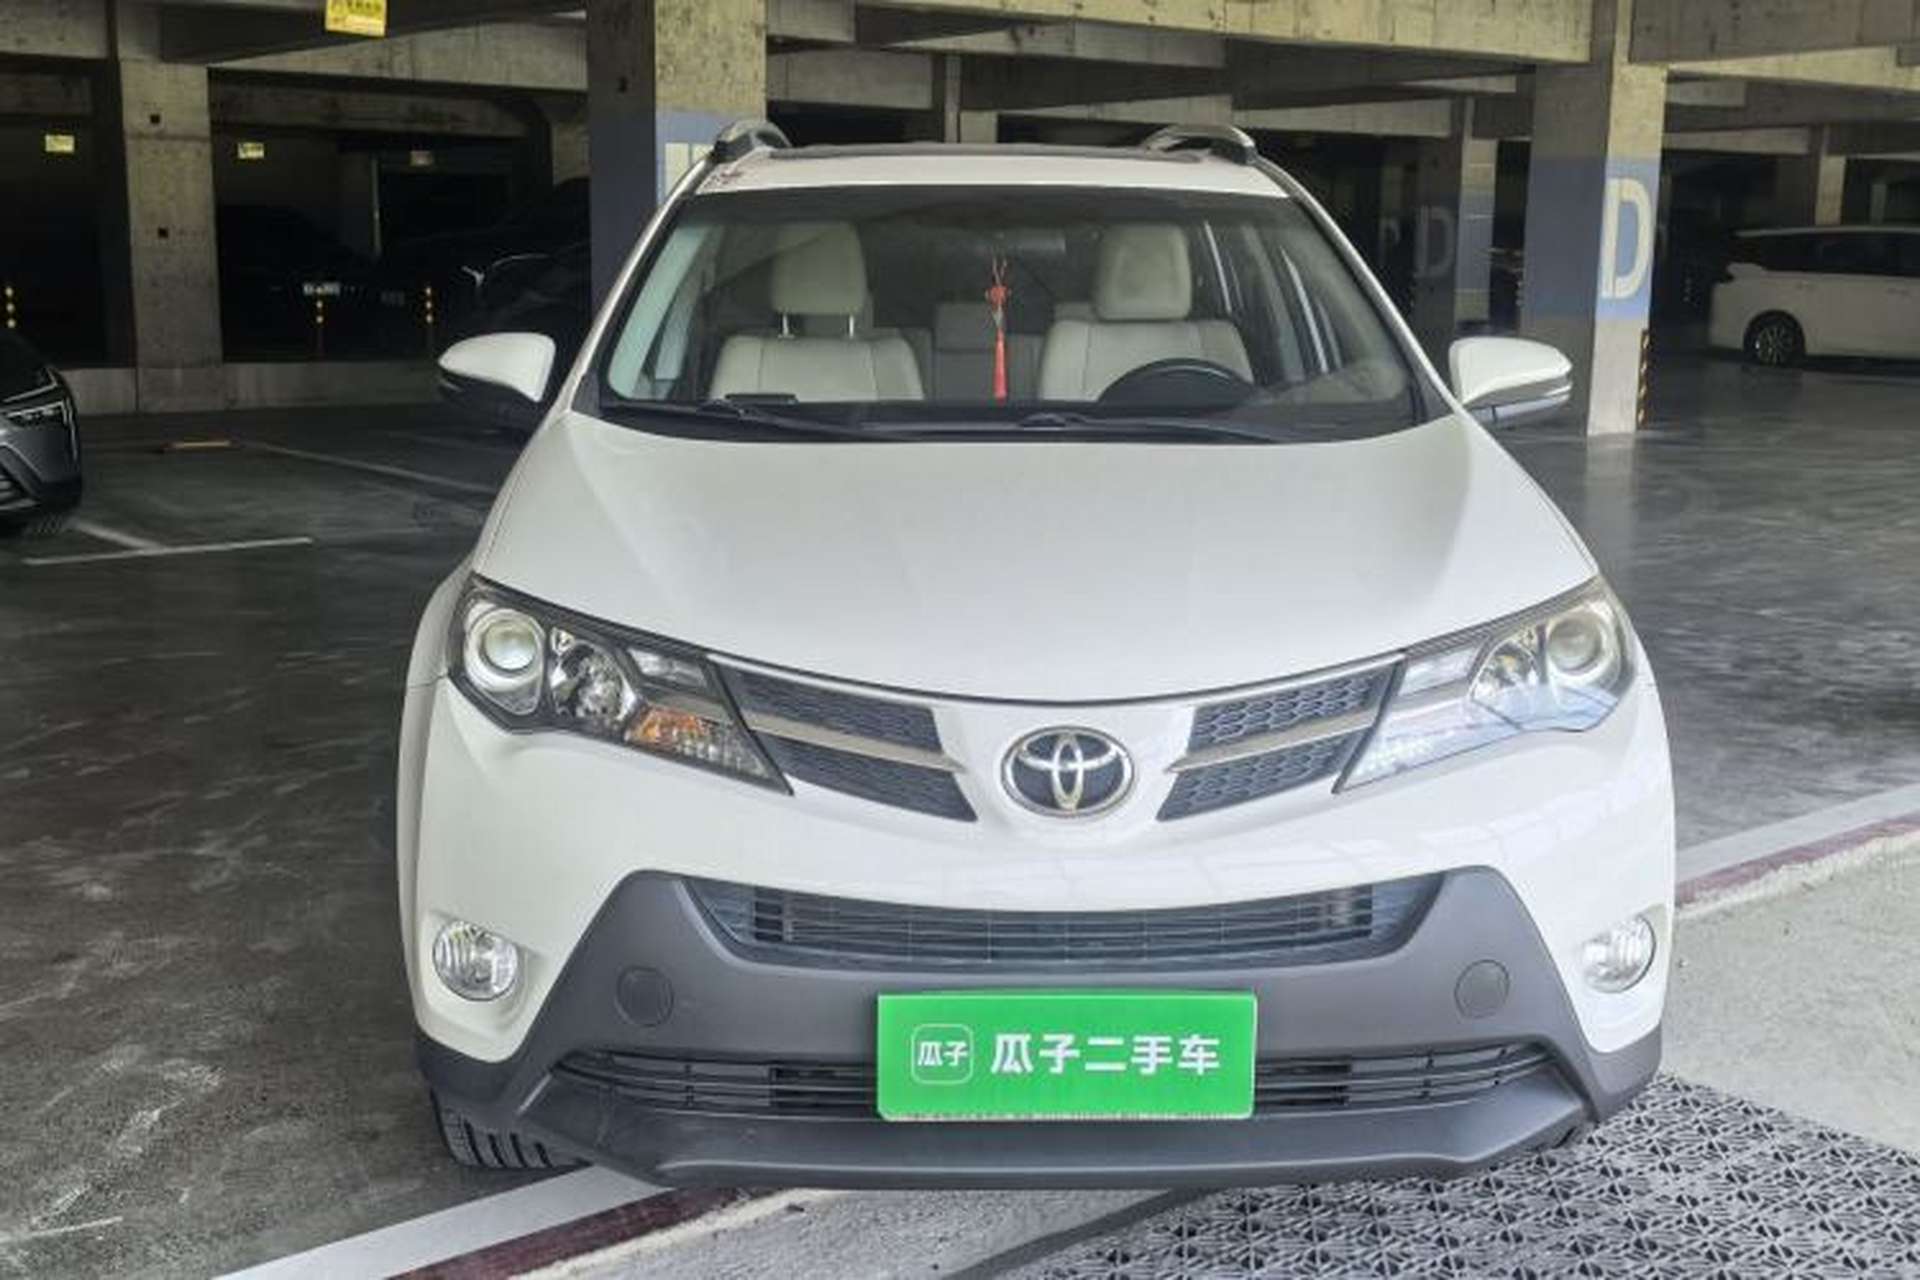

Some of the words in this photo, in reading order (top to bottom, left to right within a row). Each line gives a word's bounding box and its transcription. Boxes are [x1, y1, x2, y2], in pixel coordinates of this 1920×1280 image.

[1414, 205, 1454, 278] D
[1601, 177, 1651, 299] D
[917, 1041, 968, 1067] 瓜子
[991, 1033, 1220, 1075] 瓜子二手车
